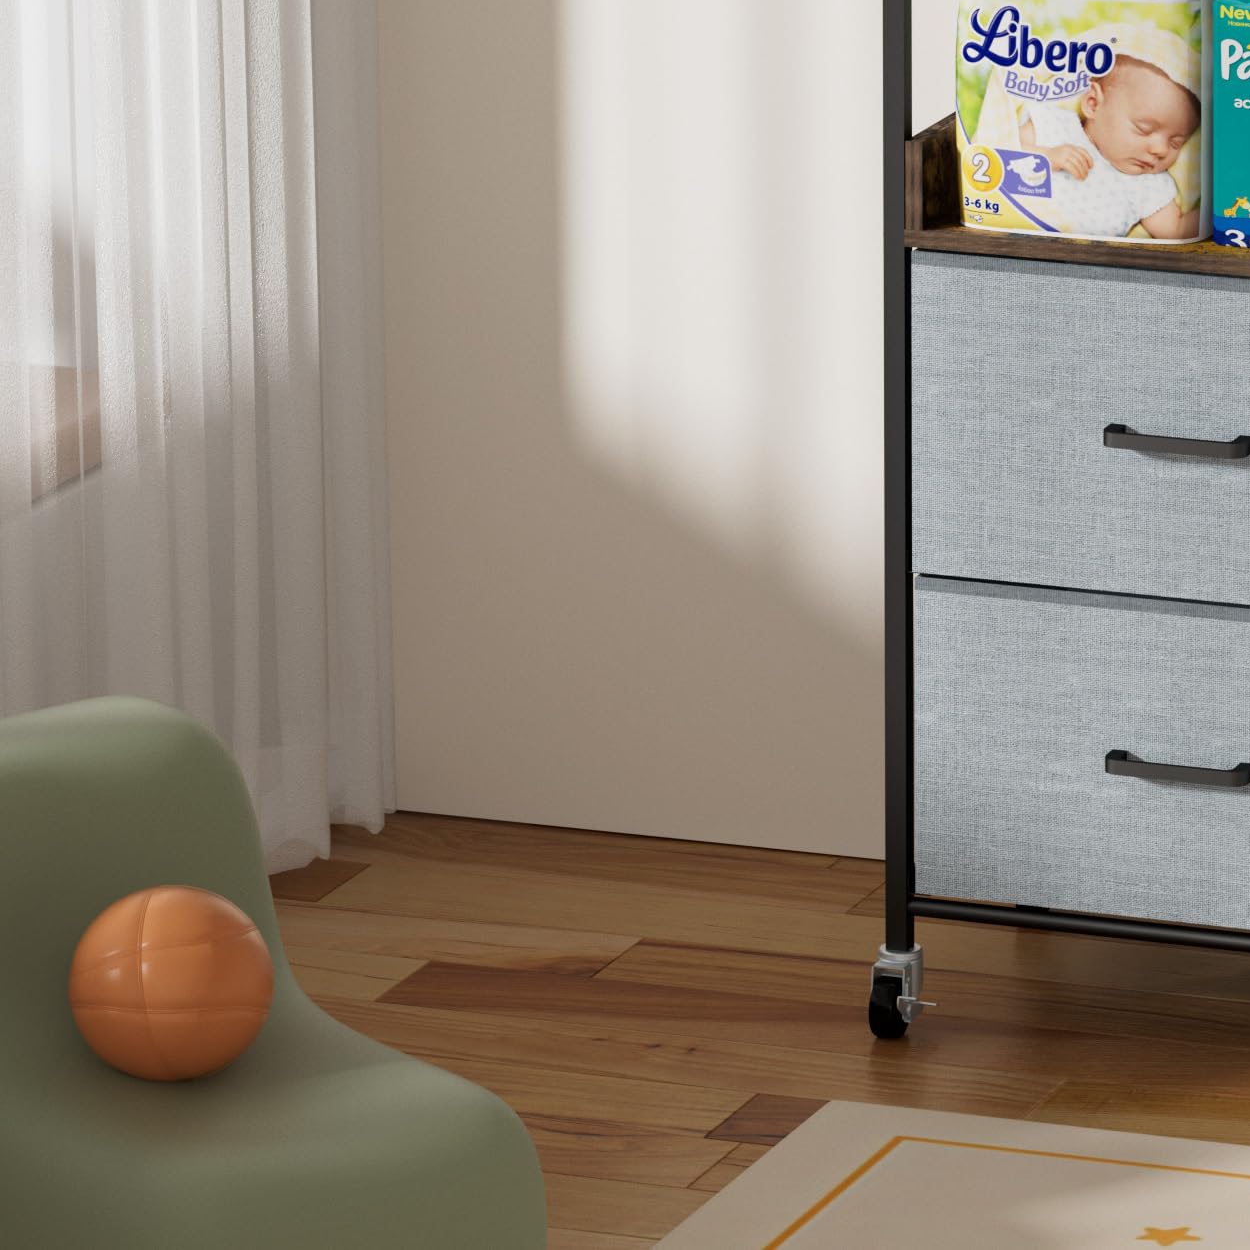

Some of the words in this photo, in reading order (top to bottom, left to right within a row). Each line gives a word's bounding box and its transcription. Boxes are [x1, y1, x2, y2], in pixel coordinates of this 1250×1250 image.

[962, 5, 1114, 76] Libero
[1004, 70, 1050, 102] Baby
[1052, 70, 1091, 96] Soft
[972, 152, 991, 183] 2
[964, 196, 981, 209] 3-6
[985, 199, 999, 213] kg
[1224, 228, 1247, 248] 3
